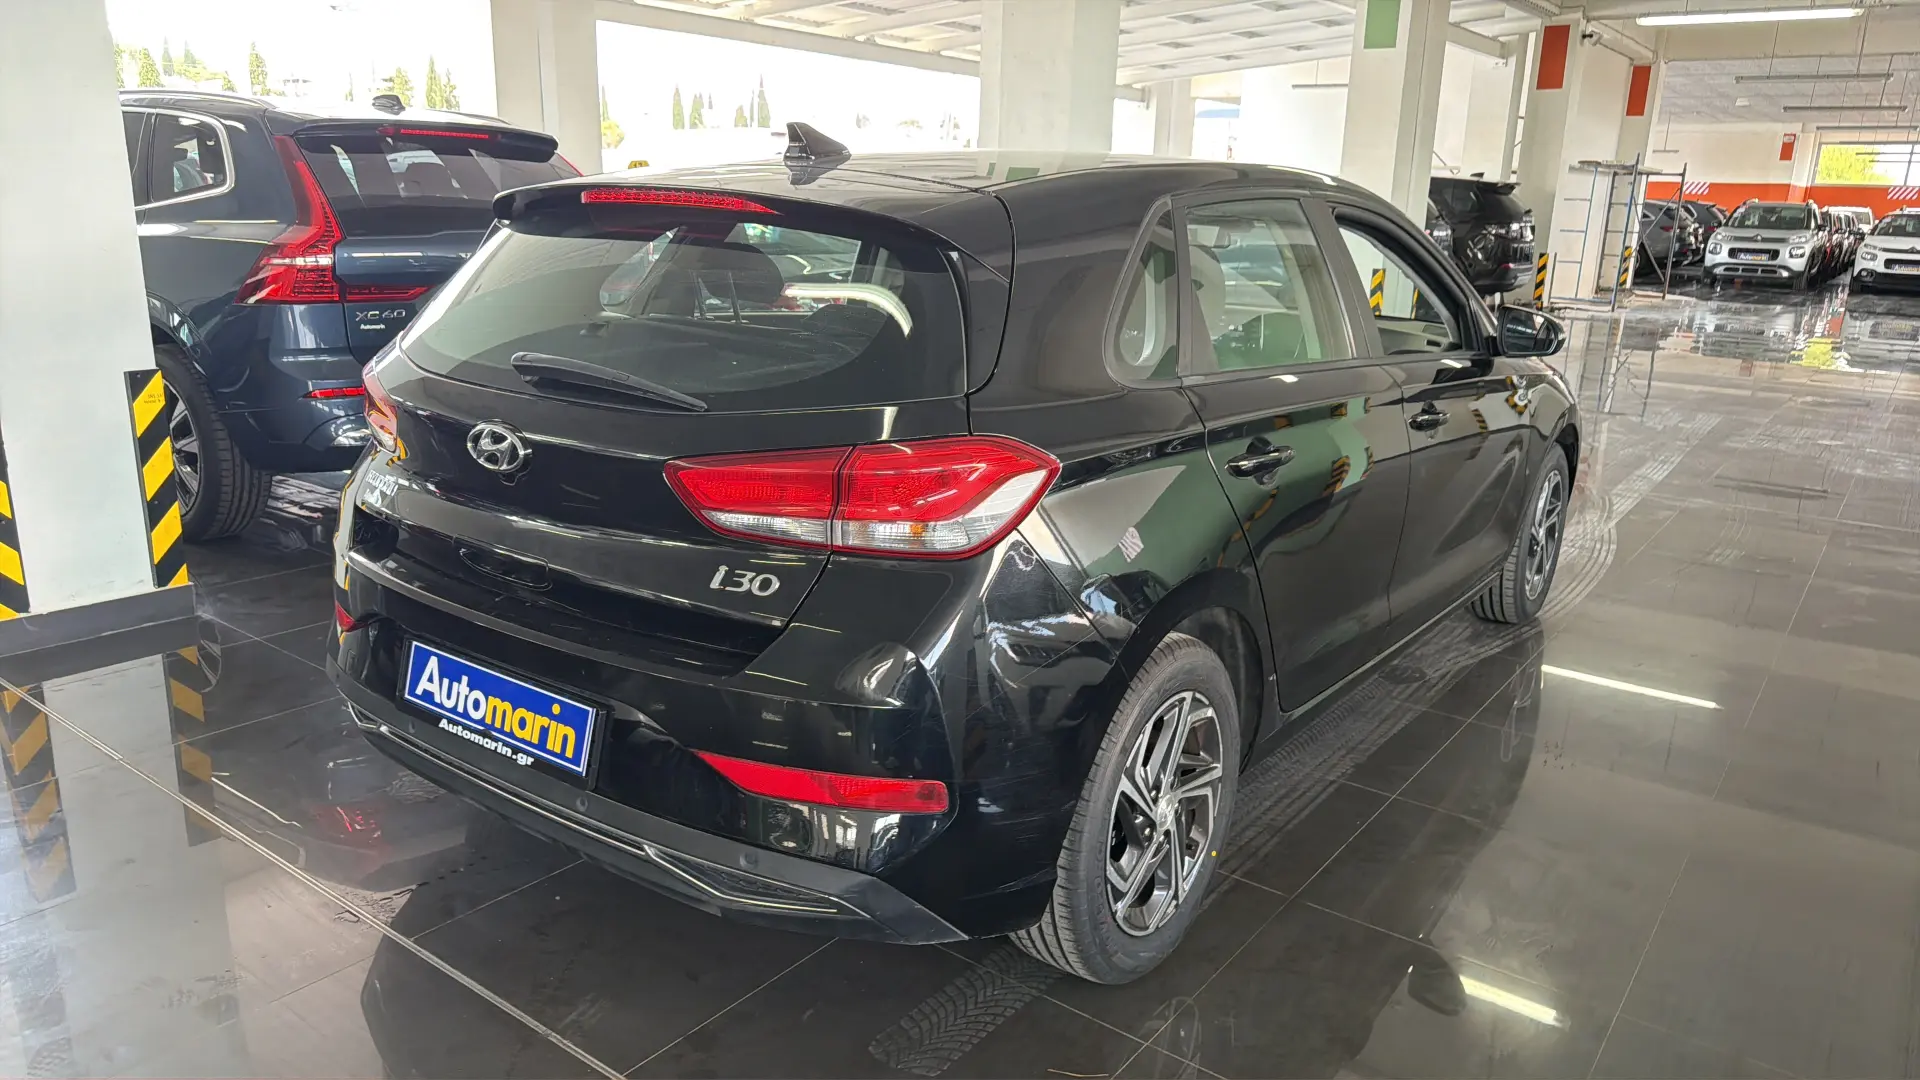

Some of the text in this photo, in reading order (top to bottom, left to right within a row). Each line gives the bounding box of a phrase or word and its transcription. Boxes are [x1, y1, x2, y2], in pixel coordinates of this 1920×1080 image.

[709, 564, 780, 597] i30
[415, 655, 576, 759] Automarin
[438, 718, 535, 766] Automarin.gr
